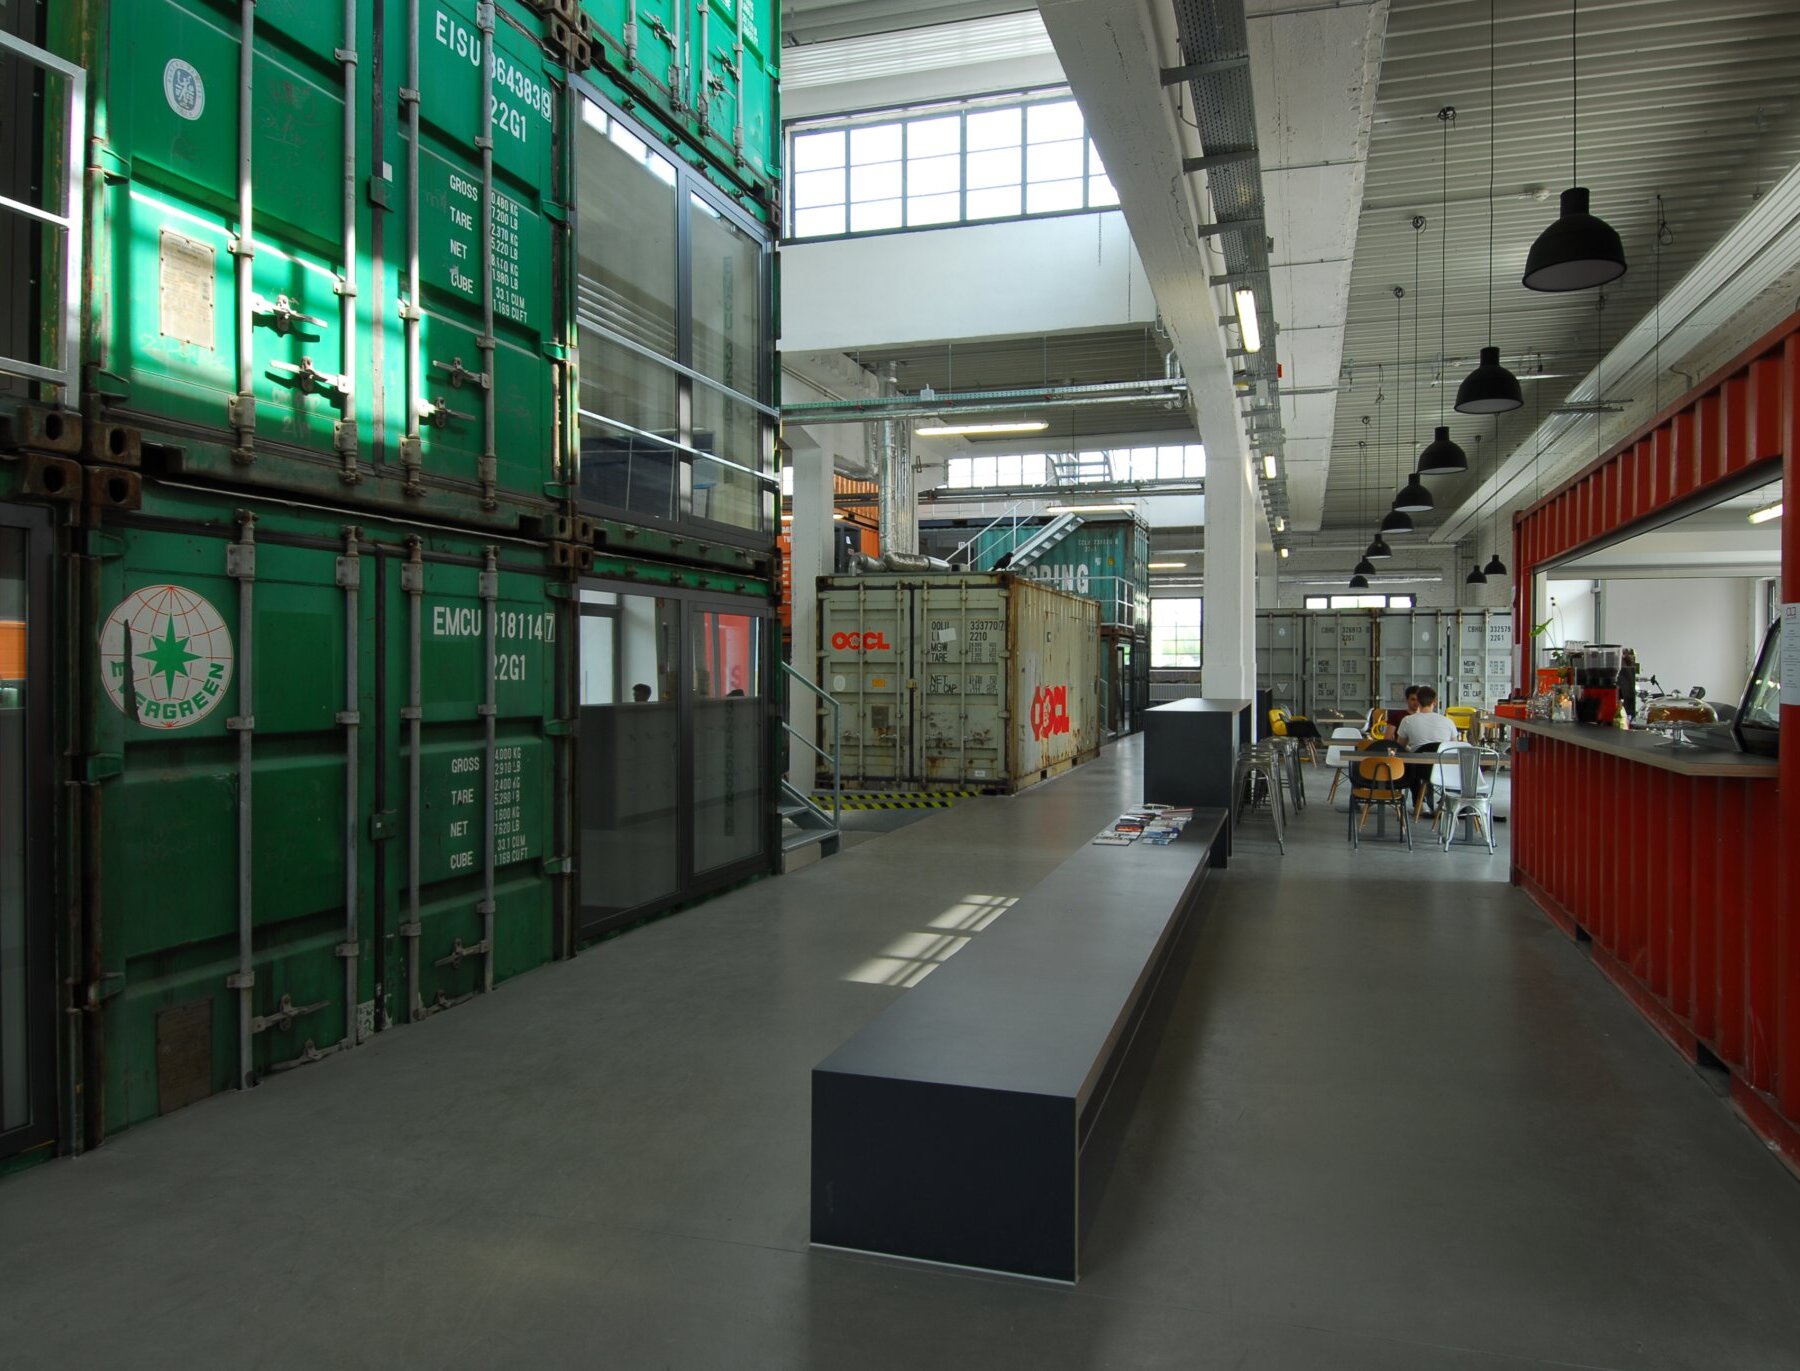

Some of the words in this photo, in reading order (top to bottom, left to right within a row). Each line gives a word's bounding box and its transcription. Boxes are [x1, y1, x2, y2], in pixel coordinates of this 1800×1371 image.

[435, 10, 481, 67] EISU
[449, 174, 478, 202] GROSS
[449, 206, 473, 231] TARE
[450, 238, 468, 260] NET
[451, 271, 474, 295] CUBE
[433, 606, 482, 636] EMCU
[495, 611, 556, 642] 181147
[831, 631, 891, 650] OOCL
[495, 654, 526, 681] 2G1
[111, 660, 225, 720] EERGREEN
[451, 757, 480, 773] GROSS
[451, 788, 475, 805] TARE
[450, 820, 468, 837] NET
[450, 851, 473, 869] CUBE
